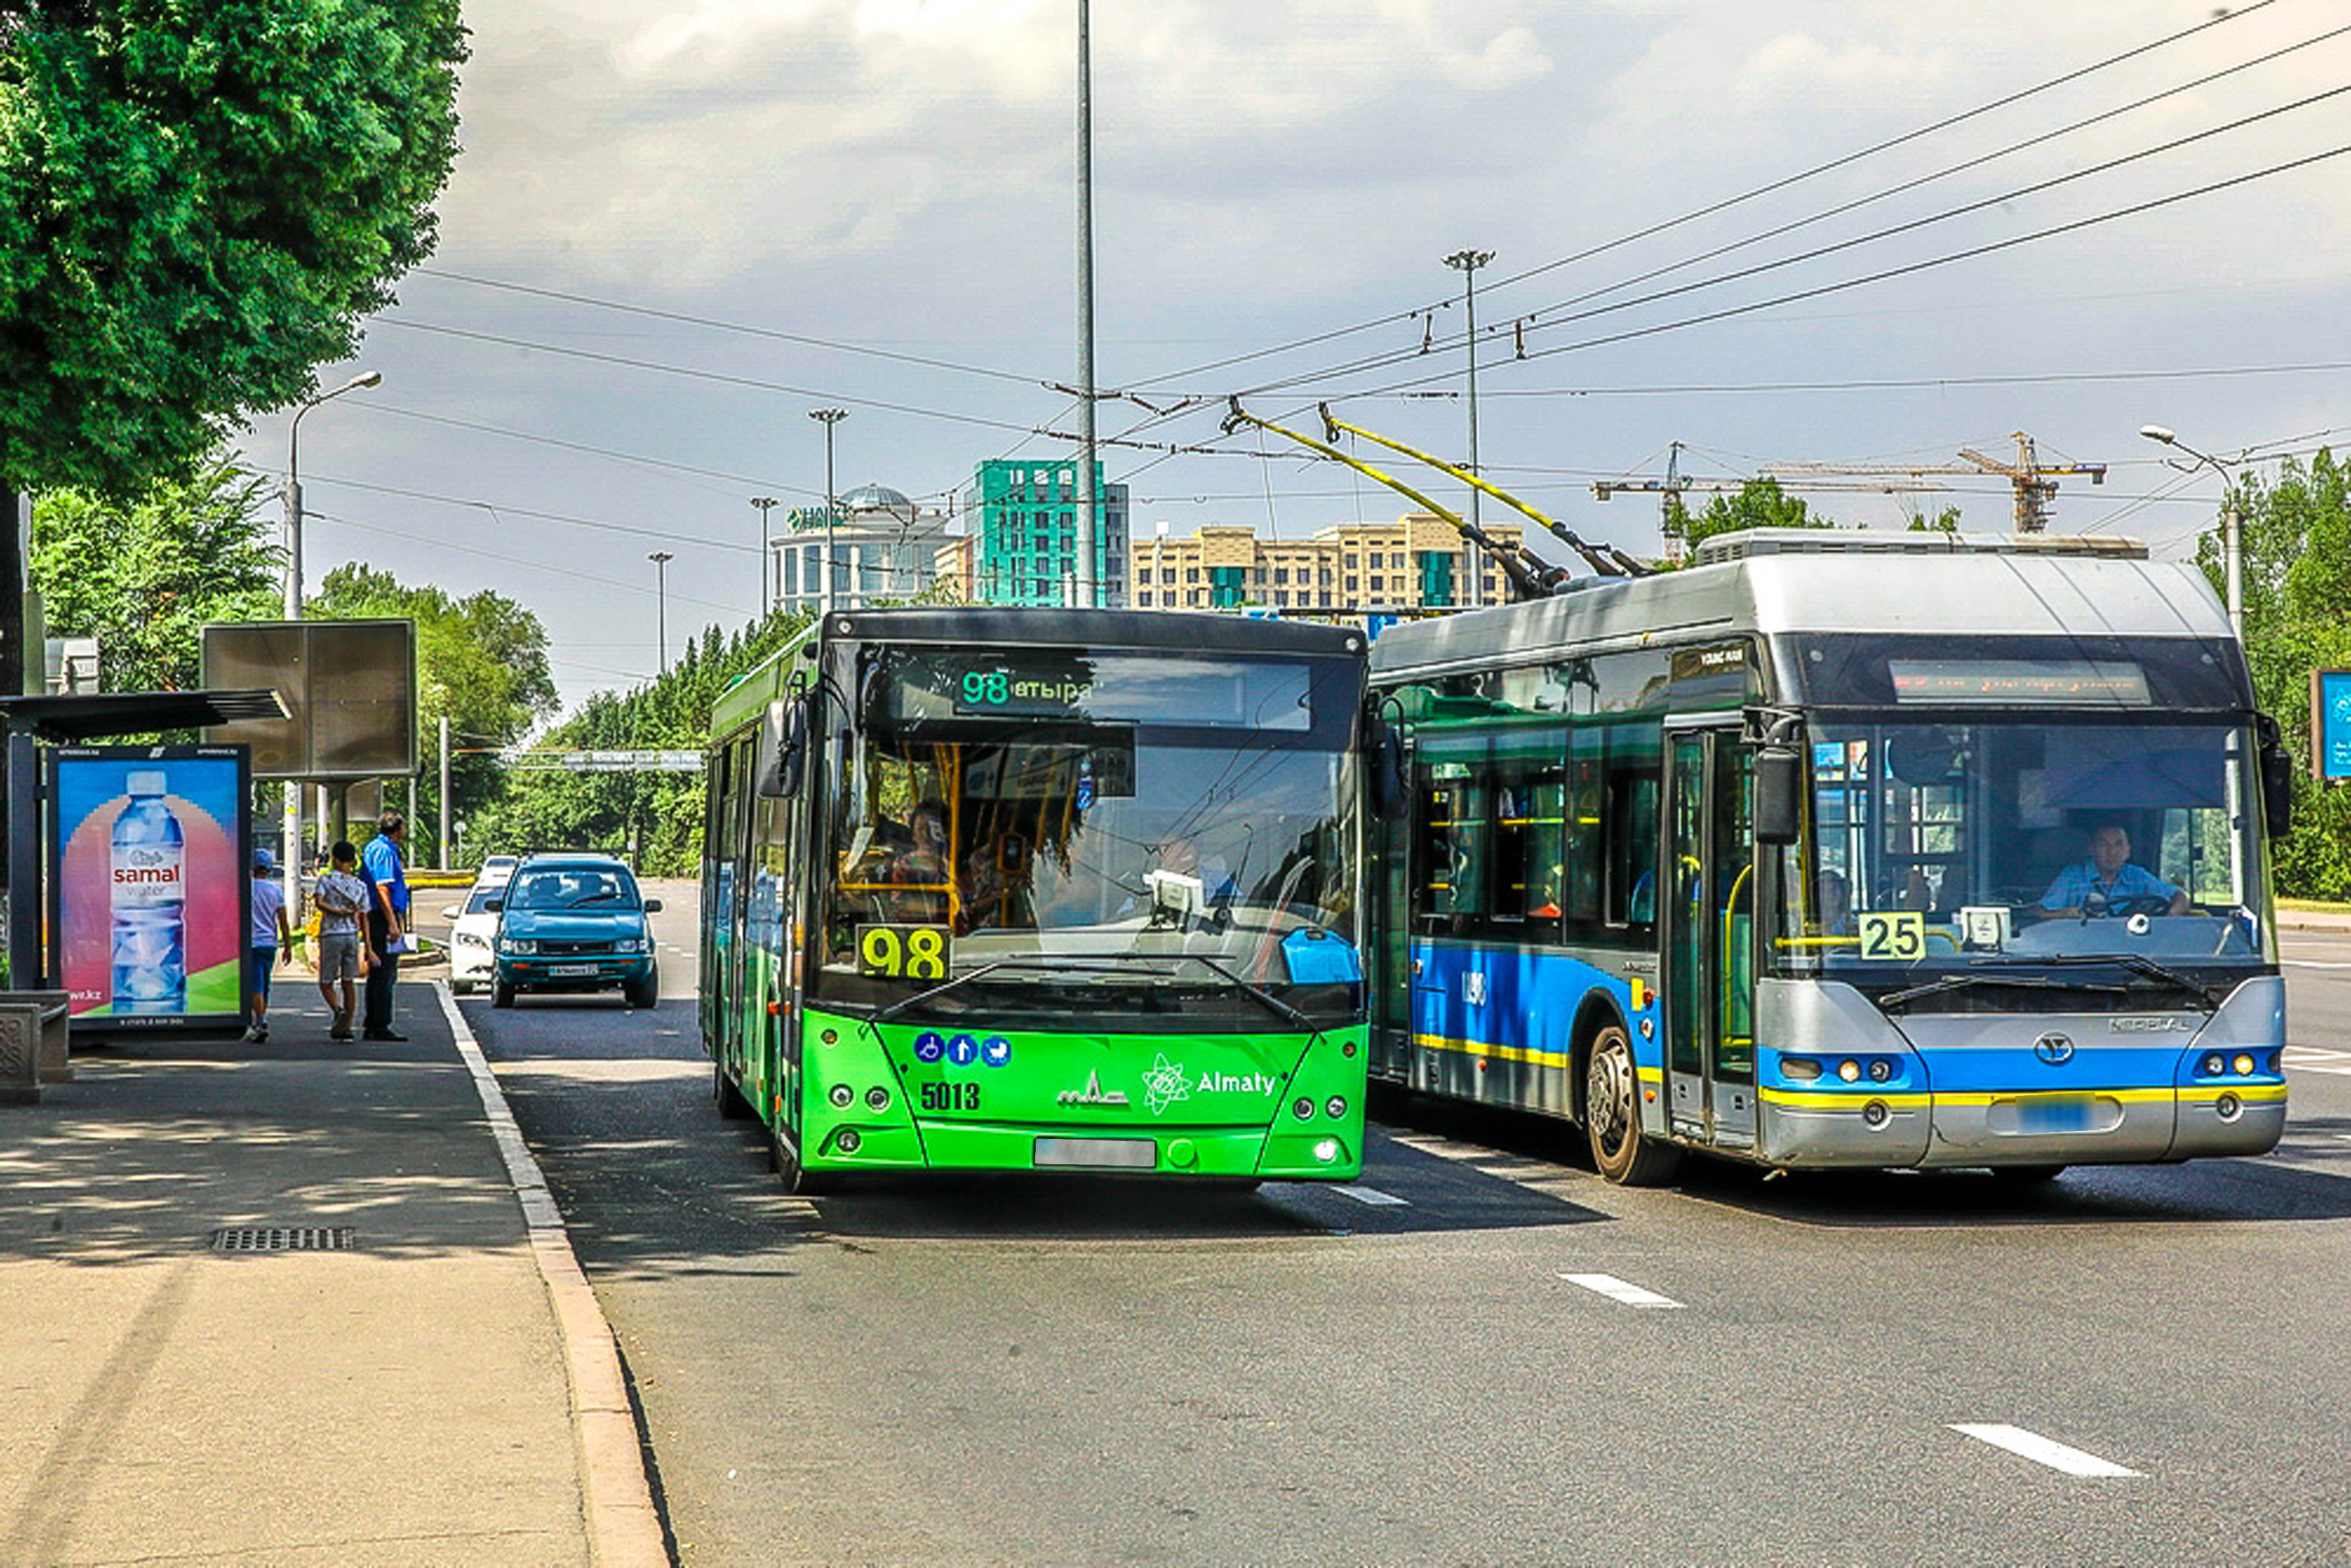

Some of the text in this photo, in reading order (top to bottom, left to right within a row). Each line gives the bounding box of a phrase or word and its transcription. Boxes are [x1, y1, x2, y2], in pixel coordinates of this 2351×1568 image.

[963, 672, 1104, 704] 98 атыра"
[113, 864, 180, 882] samal
[1866, 917, 1919, 956] 25
[863, 927, 944, 979] 98
[921, 1082, 980, 1110] 5013
[1196, 1071, 1275, 1096] Almaty
